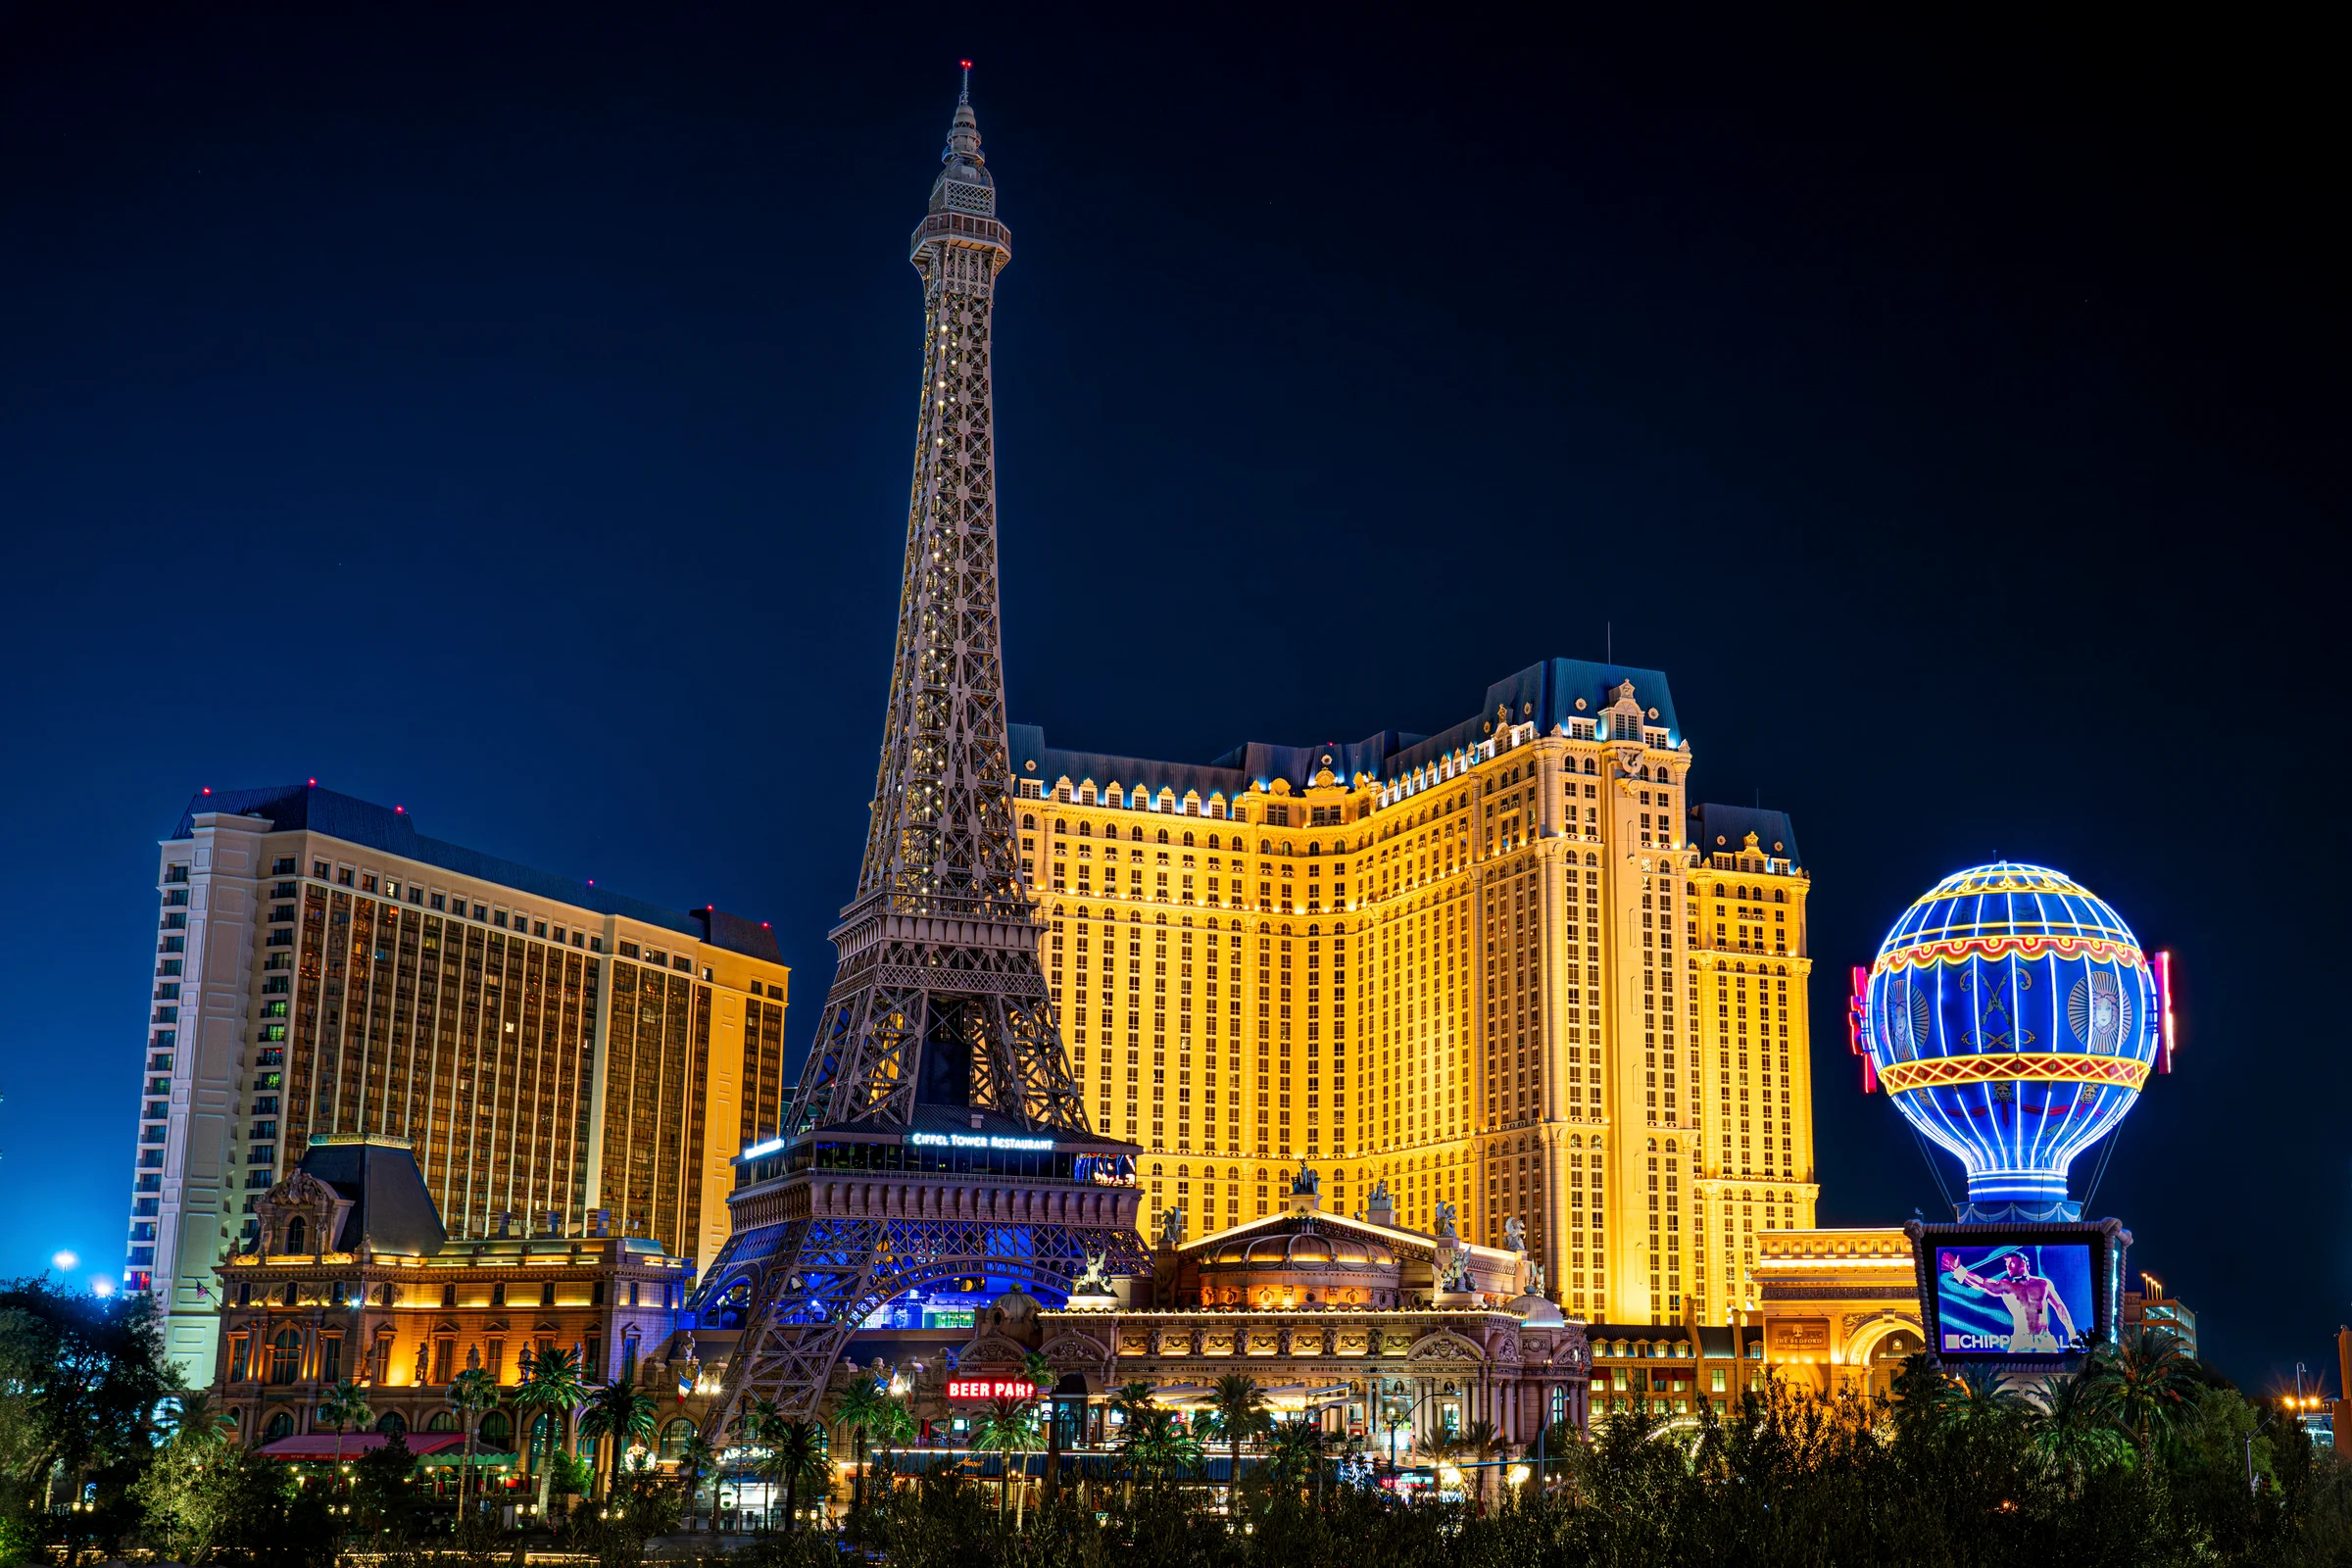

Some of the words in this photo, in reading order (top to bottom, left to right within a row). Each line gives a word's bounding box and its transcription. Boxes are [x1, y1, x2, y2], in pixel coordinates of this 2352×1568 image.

[912, 1133, 949, 1146] EIFFEL
[951, 1134, 988, 1148] TOWER
[991, 1137, 1054, 1151] RESTAURANT
[949, 1383, 990, 1396] BEER
